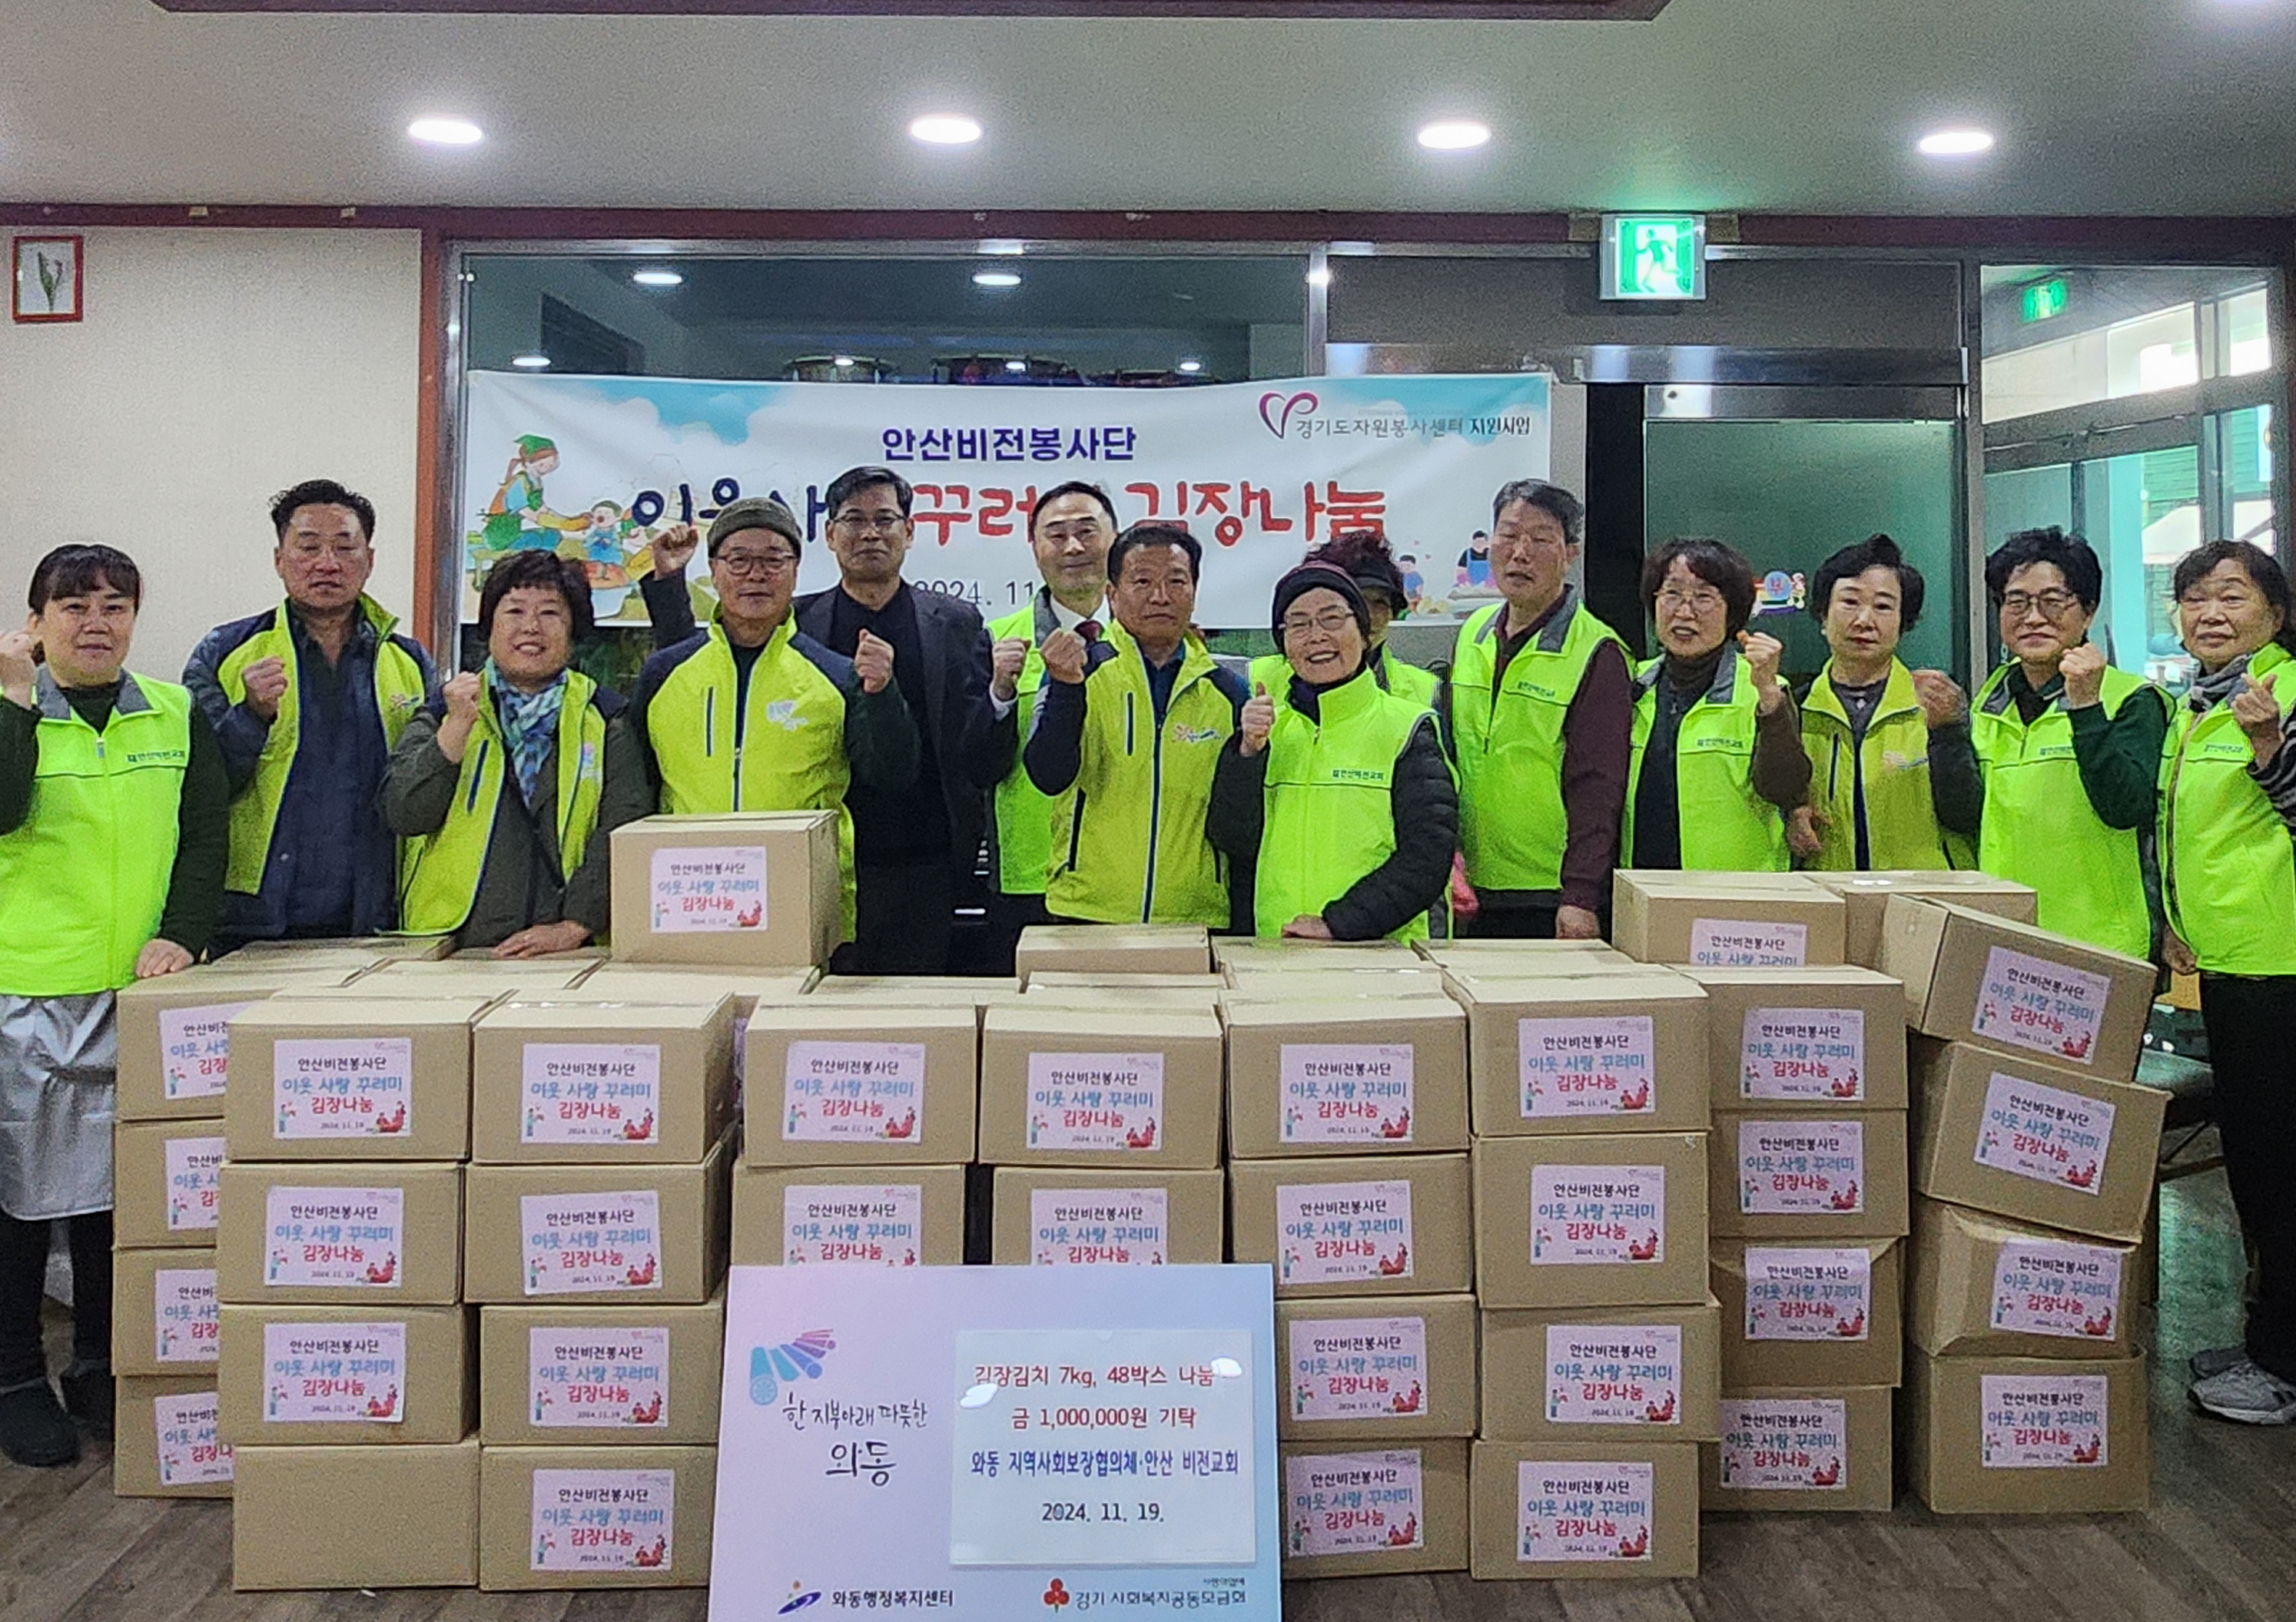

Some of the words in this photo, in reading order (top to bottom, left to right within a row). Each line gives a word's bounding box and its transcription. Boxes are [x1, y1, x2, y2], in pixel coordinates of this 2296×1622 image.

[1296, 419, 1463, 439] 경기도자원봉사센터
[882, 426, 1136, 461] 안산비전봉사단
[1125, 479, 1386, 547] 김장나눔
[1762, 1023, 1840, 1040] 안산비전봉사단
[1544, 1035, 1629, 1050] 안산비전봉사단
[1748, 1041, 1775, 1058] 이웃
[1780, 1043, 1808, 1060] 사랑
[1814, 1043, 1854, 1060] 꾸러미
[298, 1056, 387, 1072] 안산비전봉사단
[546, 1061, 635, 1078] 안산비전봉사단
[811, 1058, 900, 1076] 안산비전봉사단
[1305, 1061, 1392, 1077] 안산비전봉사단
[1528, 1055, 1558, 1073] 이웃
[1564, 1055, 1594, 1073] 사랑
[1601, 1054, 1644, 1071] 꾸러미
[1773, 1060, 1830, 1079] 김장나눔
[282, 1077, 312, 1094] 이웃
[319, 1077, 350, 1095] 사랑
[357, 1076, 402, 1093] 꾸러미
[794, 1077, 825, 1096] 이웃
[830, 1079, 862, 1098] 사랑
[868, 1080, 914, 1099] 꾸러미
[1051, 1070, 1139, 1087] 안산비전봉사단
[1558, 1074, 1618, 1092] 김장나눔
[530, 1081, 561, 1099] 이웃
[567, 1082, 599, 1100] 사랑
[605, 1083, 650, 1100] 꾸러미
[1036, 1090, 1065, 1107] 이웃
[1070, 1090, 1102, 1109] 사랑
[1108, 1091, 1153, 1109] 꾸러미
[1289, 1081, 1319, 1099] 이웃
[1325, 1082, 1356, 1100] 사랑
[1362, 1082, 1406, 1099] 꾸러미
[312, 1096, 374, 1114] 김장나눔
[559, 1101, 622, 1120] 김장나눔
[822, 1098, 885, 1118] 김장나눔
[1318, 1101, 1379, 1119] 김장나눔
[1063, 1110, 1125, 1129] 김장나눔
[1760, 1136, 1840, 1153] 안산비전봉사단
[1746, 1155, 1773, 1172] 이웃
[1779, 1156, 1807, 1173] 사랑
[1813, 1156, 1853, 1173] 꾸러미
[1773, 1174, 1829, 1192] 김장나눔
[291, 1204, 378, 1221] 안산비전봉사단
[808, 1202, 897, 1219] 안산비전봉사단
[1055, 1206, 1143, 1222] 안산비전봉사단
[1300, 1199, 1387, 1216] 안산비전봉사단
[275, 1223, 304, 1242] 이웃
[310, 1225, 342, 1243] 사랑
[347, 1226, 393, 1243] 꾸러미
[791, 1222, 822, 1241] 이웃
[828, 1223, 860, 1242] 사랑
[866, 1223, 911, 1241] 꾸러미
[1040, 1226, 1069, 1244] 이웃
[1076, 1226, 1107, 1245] 사랑
[1113, 1226, 1158, 1244] 꾸러미
[1285, 1222, 1316, 1239] 이웃
[1321, 1220, 1353, 1239] 사랑
[1359, 1219, 1402, 1236] 꾸러미
[303, 1244, 365, 1264] 김장나눔
[821, 1242, 884, 1261] 김장나눔
[1069, 1246, 1130, 1264] 김장나눔
[1315, 1239, 1377, 1259] 김장나눔
[555, 1345, 644, 1362] 안산비전봉사단
[1313, 1336, 1402, 1352] 안산비전봉사단
[1570, 1342, 1657, 1360] 안산비전봉사단
[539, 1365, 569, 1383] 이웃
[576, 1365, 607, 1384] 사랑
[613, 1365, 659, 1383] 꾸러미
[1299, 1358, 1329, 1375] 이웃
[1335, 1357, 1366, 1375] 사랑
[1372, 1355, 1416, 1373] 꾸러미
[1554, 1362, 1584, 1381] 이웃
[1590, 1363, 1621, 1382] 사랑
[1627, 1364, 1672, 1382] 꾸러미
[975, 1366, 1049, 1387] 김장김치
[1059, 1366, 1097, 1388] 7kg,
[1107, 1365, 1168, 1387] 48박스
[1179, 1365, 1215, 1387] 나눔
[1329, 1376, 1390, 1395] 김장나눔
[569, 1385, 630, 1404] 김장나눔
[1583, 1382, 1644, 1402] 김장나눔
[782, 1391, 807, 1431] 한
[878, 1398, 928, 1428] 따뜻한
[1012, 1408, 1030, 1429] 금
[1040, 1407, 1148, 1430] 1,000,000원
[1160, 1407, 1196, 1428] 기탁
[971, 1450, 1000, 1478] 와동
[1183, 1449, 1239, 1477] 비전교회
[559, 1487, 649, 1504] 안산비전봉사단
[1543, 1478, 1630, 1496] 안산비전봉사단
[542, 1508, 572, 1526] 이웃
[579, 1508, 612, 1527] 사랑
[617, 1508, 663, 1527] 꾸러미
[1042, 1502, 1091, 1523] 2024.
[1100, 1502, 1127, 1523] 11.
[1137, 1502, 1164, 1523] 19.
[1527, 1498, 1557, 1517] 이웃
[1563, 1500, 1594, 1518] 사랑
[1601, 1500, 1644, 1518] 꾸러미
[571, 1528, 635, 1547] 김장나눔
[1556, 1519, 1617, 1537] 김장나눔
[831, 1590, 953, 1608] 와동행정복지센터
[1076, 1591, 1104, 1610] 경기
[1110, 1590, 1246, 1609] 사회복지공동모금회
